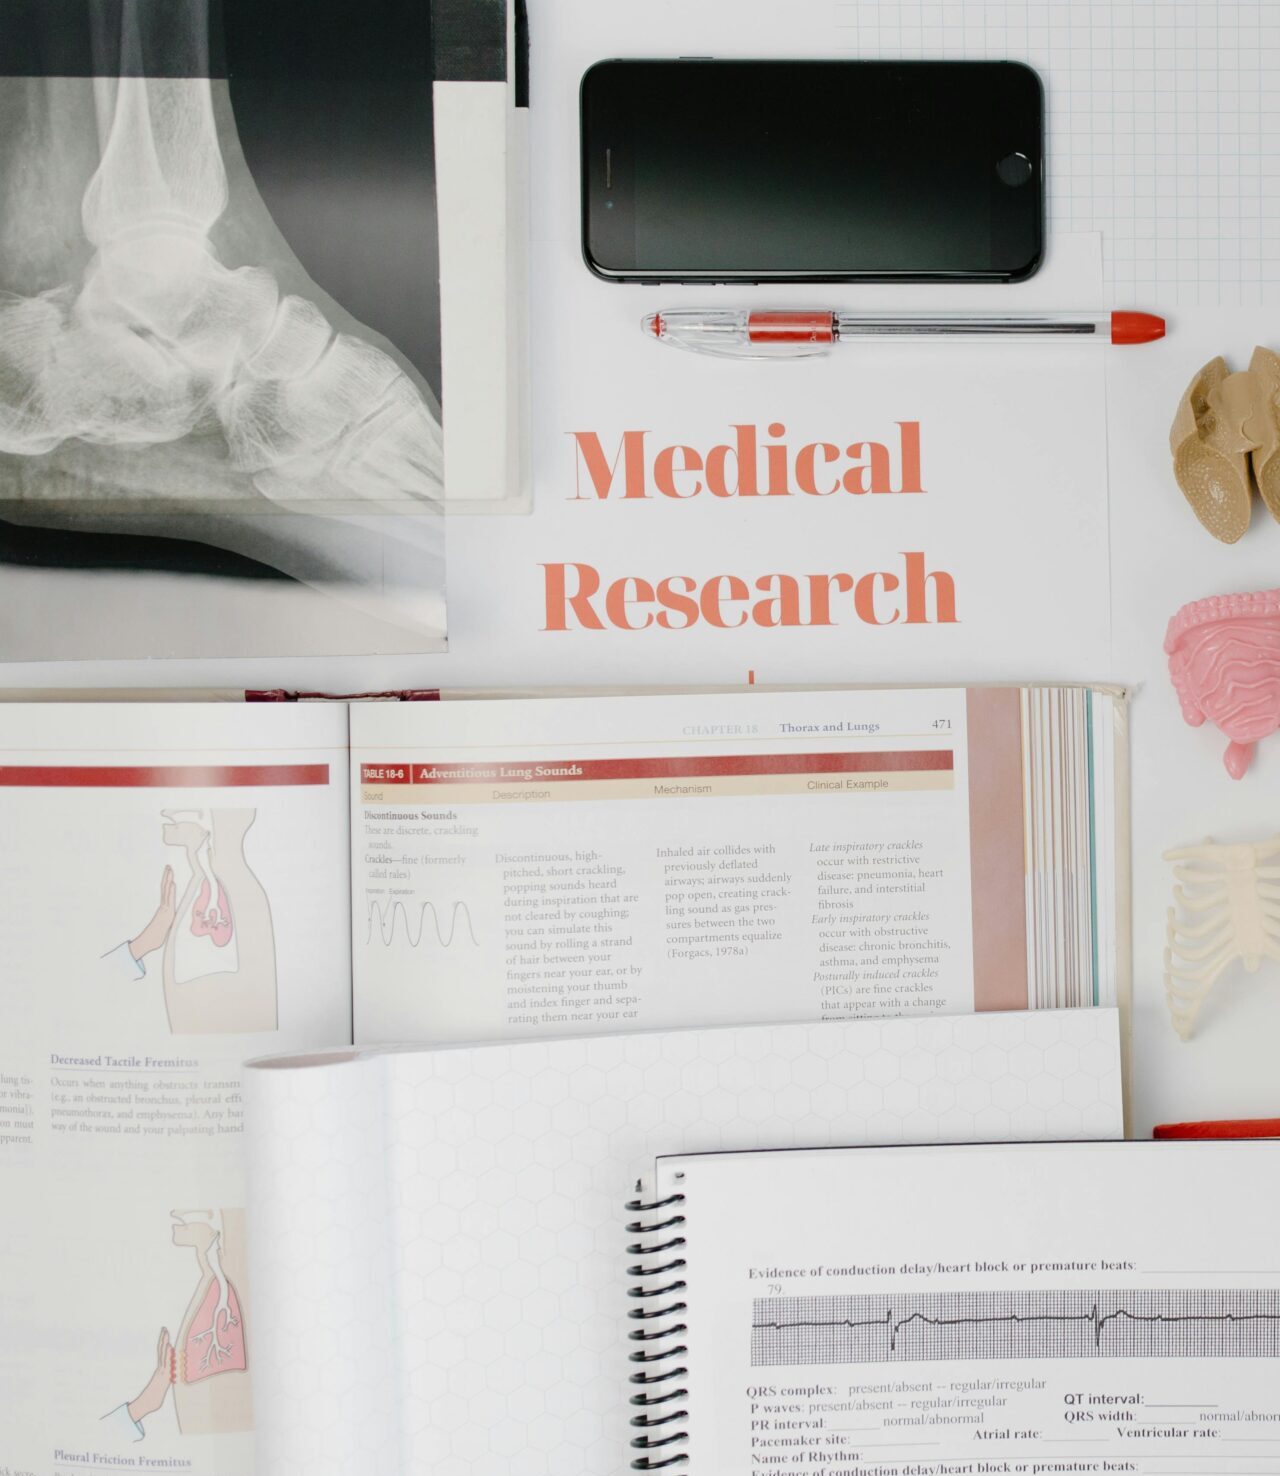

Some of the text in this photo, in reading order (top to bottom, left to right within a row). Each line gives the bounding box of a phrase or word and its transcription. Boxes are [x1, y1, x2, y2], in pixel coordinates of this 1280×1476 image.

[564, 421, 928, 500] Medical
[537, 551, 961, 631] Research
[683, 724, 742, 735] CHAPTER
[779, 721, 880, 734] Thorax and Lungs
[931, 719, 951, 729] 471
[363, 768, 404, 779] TABLE 18-6
[420, 764, 583, 780] Adventitious Lung Sounds
[653, 783, 712, 795] Mechanism
[806, 778, 889, 791] Clinical Example
[363, 790, 384, 801] Sound
[492, 789, 550, 802] Description
[364, 810, 457, 821] Discontinuous Sounds
[656, 843, 776, 858] Inhaled air collides with
[809, 839, 924, 854] Late inspiratory crackles
[495, 849, 603, 864] Discontinuous, high-
[816, 854, 920, 866] occur with restrictive
[503, 863, 626, 881] pitched, short crackling,
[664, 858, 758, 875] previously deflated
[664, 871, 792, 888] airways; airways suddenly
[817, 867, 943, 882] disease: pneumonia, heart
[503, 878, 617, 895] popping sounds heard
[818, 882, 925, 895] failure, and interstitial
[818, 898, 854, 910] fibrosis
[811, 911, 930, 926] Early inspiratory crackles
[50, 1054, 199, 1068] Decreased Tactile Fremitus
[749, 1259, 1137, 1279] Evidence of conduction delay/heart block or premature beats:
[746, 1386, 777, 1400] QRS
[780, 1384, 837, 1398] complex:
[848, 1380, 933, 1397] present/absent
[950, 1377, 1047, 1394] regular/irregular
[751, 1403, 759, 1414] P
[763, 1405, 805, 1413] waves:
[809, 1399, 893, 1415] present/absent
[911, 1394, 1008, 1412] regular/irregular
[1064, 1393, 1144, 1405] QT interval:
[751, 1417, 827, 1431] PR interval:
[883, 1412, 984, 1427] normal/abnormal
[1064, 1410, 1137, 1424] QRS width:
[973, 1429, 1042, 1440] Atrial rate:
[1117, 1427, 1222, 1438] Ventricular rate:
[751, 1433, 850, 1448] Pacemaker site:
[54, 1449, 192, 1468] Pleural Friction Fremitus
[751, 1450, 863, 1464] Name of Rhythm:
